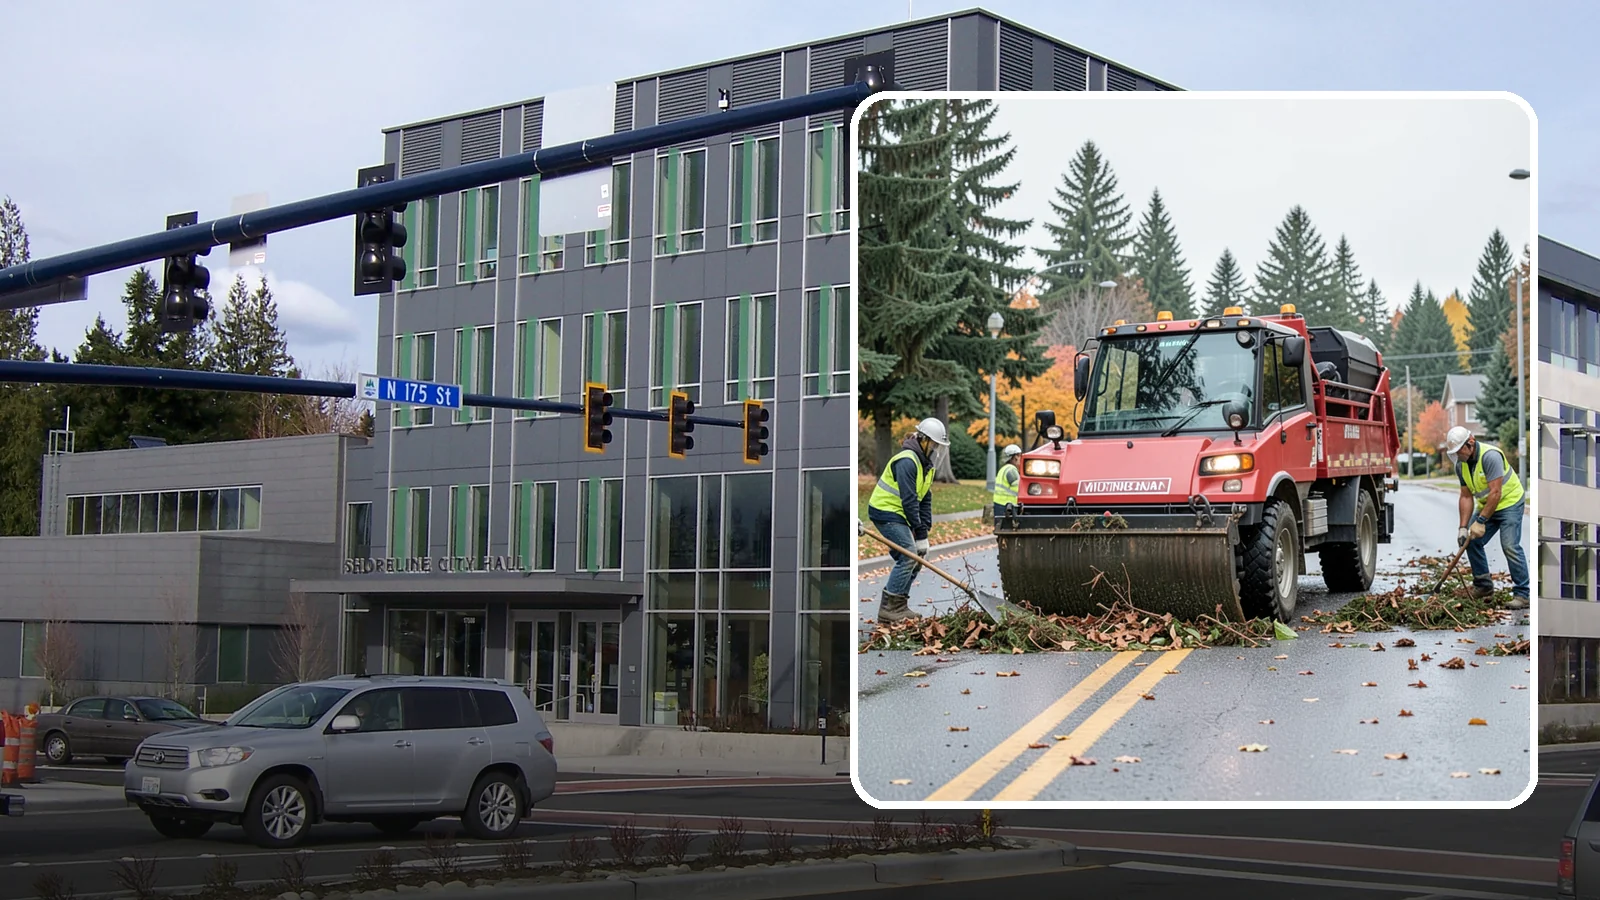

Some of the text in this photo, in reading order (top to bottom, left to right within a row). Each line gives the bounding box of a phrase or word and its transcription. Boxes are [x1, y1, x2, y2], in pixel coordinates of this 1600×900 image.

[387, 380, 451, 406] N 175 St
[345, 556, 525, 573] SHORELINE CITY HALL
